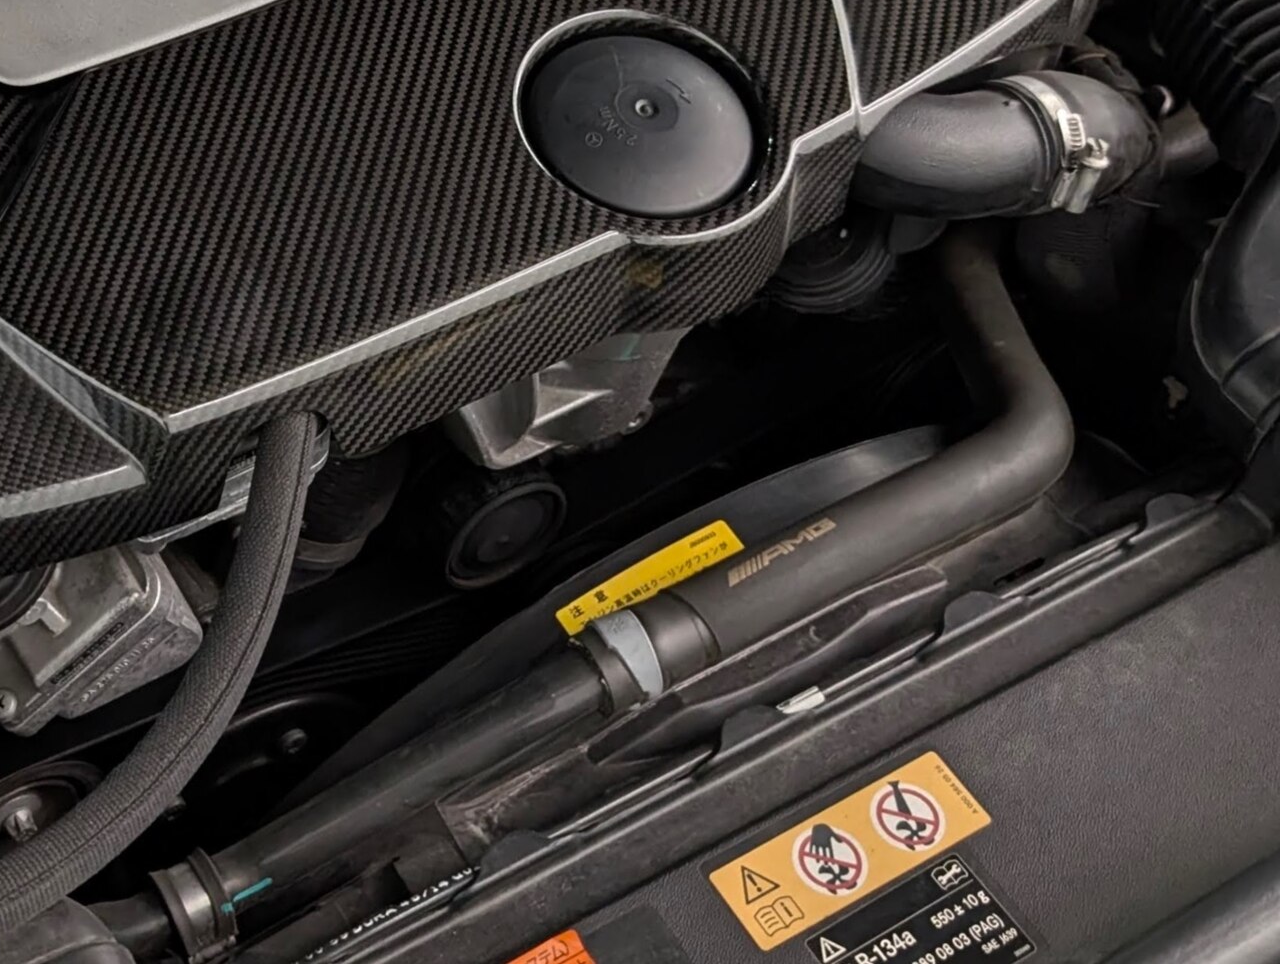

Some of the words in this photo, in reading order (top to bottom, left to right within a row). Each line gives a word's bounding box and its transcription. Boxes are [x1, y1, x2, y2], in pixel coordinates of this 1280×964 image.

[855, 930, 917, 964] R-134a
[930, 908, 956, 929] 550
[963, 892, 979, 909] 10
[979, 889, 990, 904] g
[935, 942, 955, 960] 08
[952, 932, 971, 949] 03
[970, 912, 1005, 942] (PAG)
[981, 940, 1001, 955] SAE
[1000, 927, 1018, 947] J639
